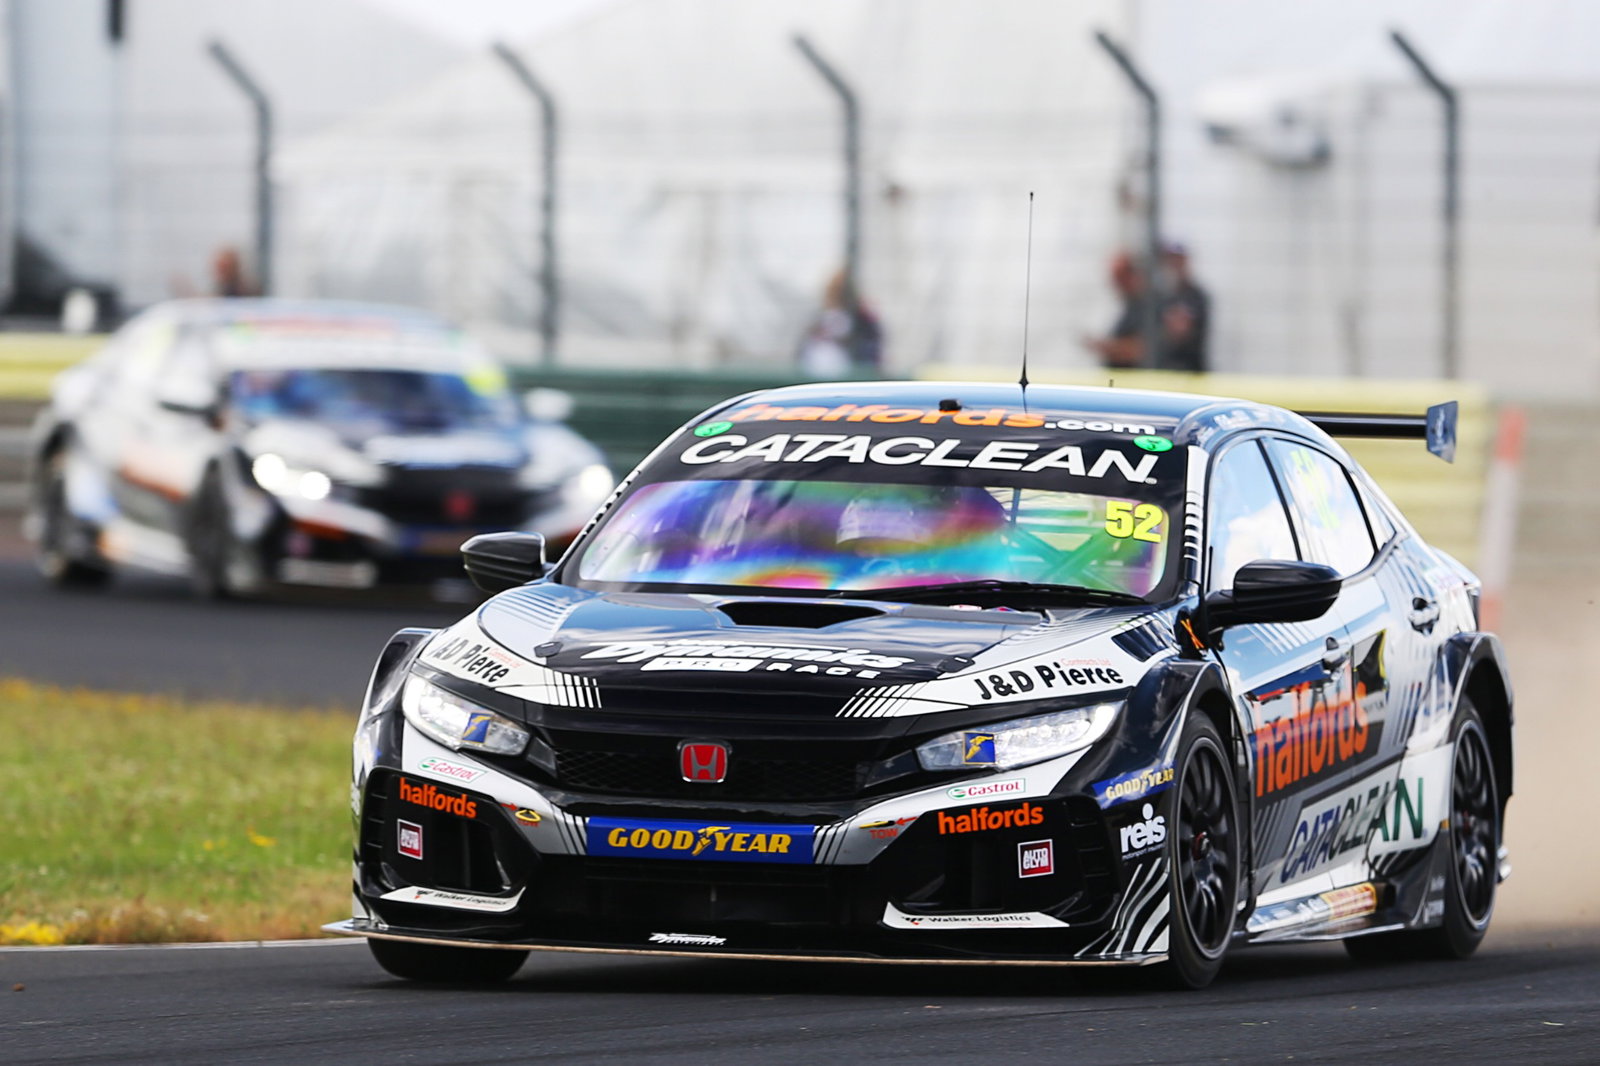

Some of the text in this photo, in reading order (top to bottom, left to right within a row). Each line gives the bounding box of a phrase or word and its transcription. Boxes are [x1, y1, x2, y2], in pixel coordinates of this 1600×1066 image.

[1105, 500, 1163, 543] 52
[454, 644, 510, 682] Pierce
[765, 662, 881, 679] RACE
[974, 662, 1123, 700] J&D Pierce
[1256, 660, 1369, 797] halfords
[432, 762, 478, 780] Castrol
[968, 781, 1020, 796] Castrol
[400, 777, 477, 818] halfords
[870, 828, 898, 840] TOW
[938, 802, 1044, 834] halfords
[1120, 803, 1166, 853] reis
[976, 915, 1031, 923] Logistics
